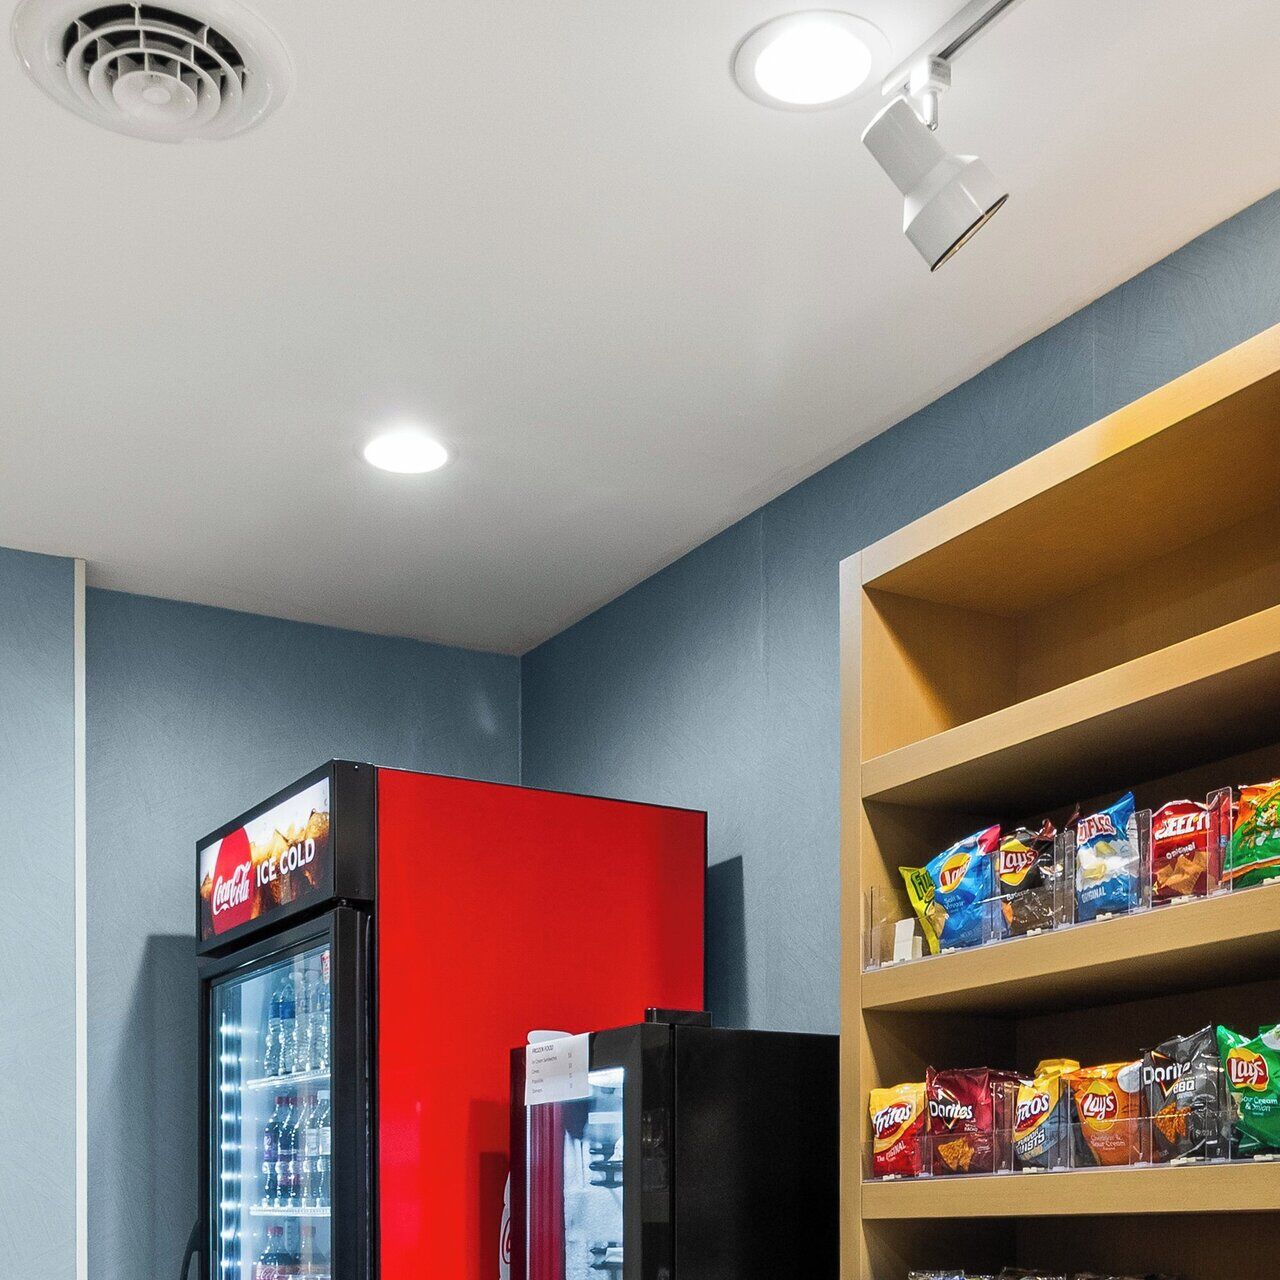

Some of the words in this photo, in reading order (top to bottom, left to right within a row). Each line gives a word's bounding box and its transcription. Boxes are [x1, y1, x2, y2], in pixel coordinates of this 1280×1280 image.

[256, 858, 277, 887] ICE
[279, 839, 315, 875] COLD
[1000, 850, 1034, 873] Lay's
[1081, 888, 1106, 903] ORIGINAL
[1143, 1061, 1191, 1085] Dorito
[1230, 1059, 1266, 1085] Lay's
[929, 1101, 973, 1119] Doritos
[1084, 1090, 1114, 1119] Lay's
[1254, 1096, 1277, 1104] Cream
[873, 1104, 912, 1137] Fritos
